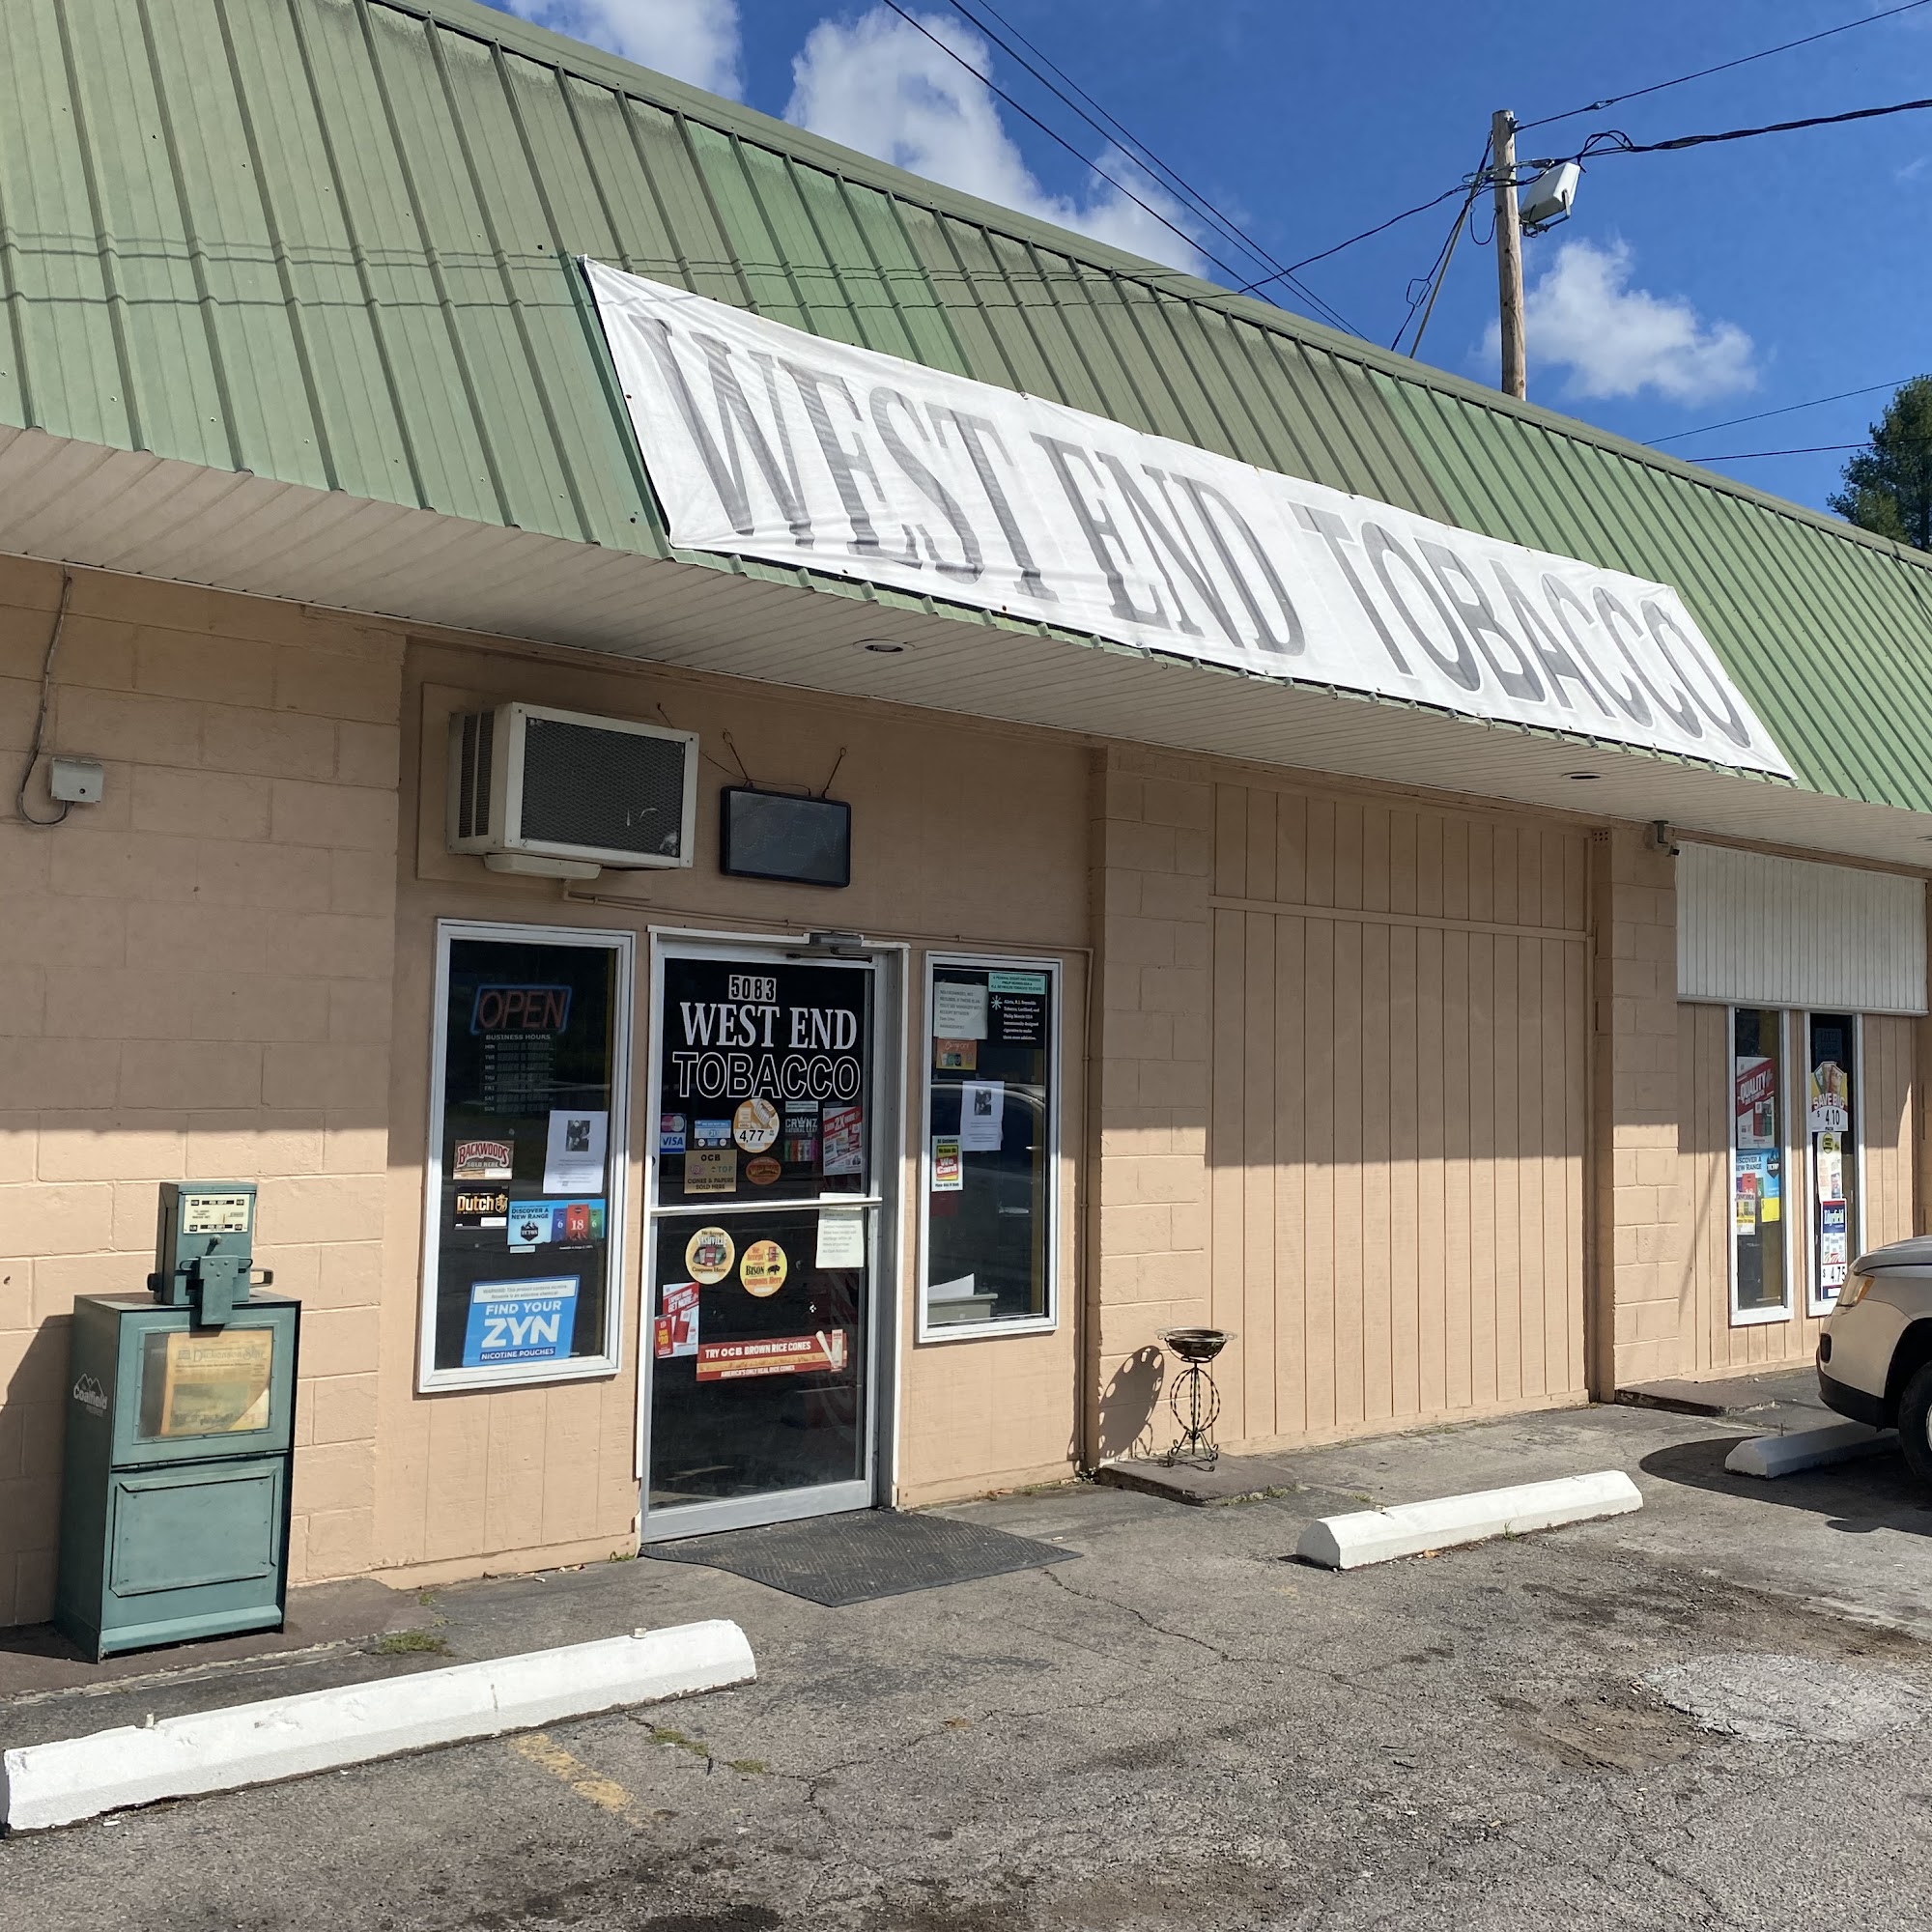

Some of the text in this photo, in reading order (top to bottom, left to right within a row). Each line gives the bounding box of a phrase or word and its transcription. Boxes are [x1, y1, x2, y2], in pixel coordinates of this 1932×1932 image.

[627, 314, 1751, 749] WEST END TOBACCO
[731, 976, 776, 1001] 5083
[479, 990, 567, 1029] OPEN
[680, 1002, 858, 1050] WEST END
[672, 1051, 861, 1100] TOBACCO
[1740, 1070, 1767, 1104] QUALITY
[1813, 1093, 1845, 1110] SAVE BIG
[835, 1115, 845, 1131] 2X
[663, 1136, 684, 1146] VISA
[457, 1142, 510, 1168] BACKWOODS
[940, 1157, 954, 1167] We
[937, 1163, 957, 1175] Card
[457, 1195, 495, 1211] Dutch
[557, 1220, 563, 1229] 6
[571, 1220, 584, 1231] 18
[746, 1265, 765, 1276] BISON
[486, 1300, 562, 1316] FIND YOUR
[481, 1314, 560, 1349] ZYN
[481, 1348, 554, 1360] NICOTINE POUCHES
[705, 1341, 811, 1359] TRY OCB BROWN RICE CONES
[721, 1368, 746, 1378] AMERICA'S
[746, 1367, 757, 1376] ONLY
[757, 1366, 769, 1375] REAL
[769, 1365, 780, 1374] RICE
[73, 1384, 108, 1410] Coalfield
